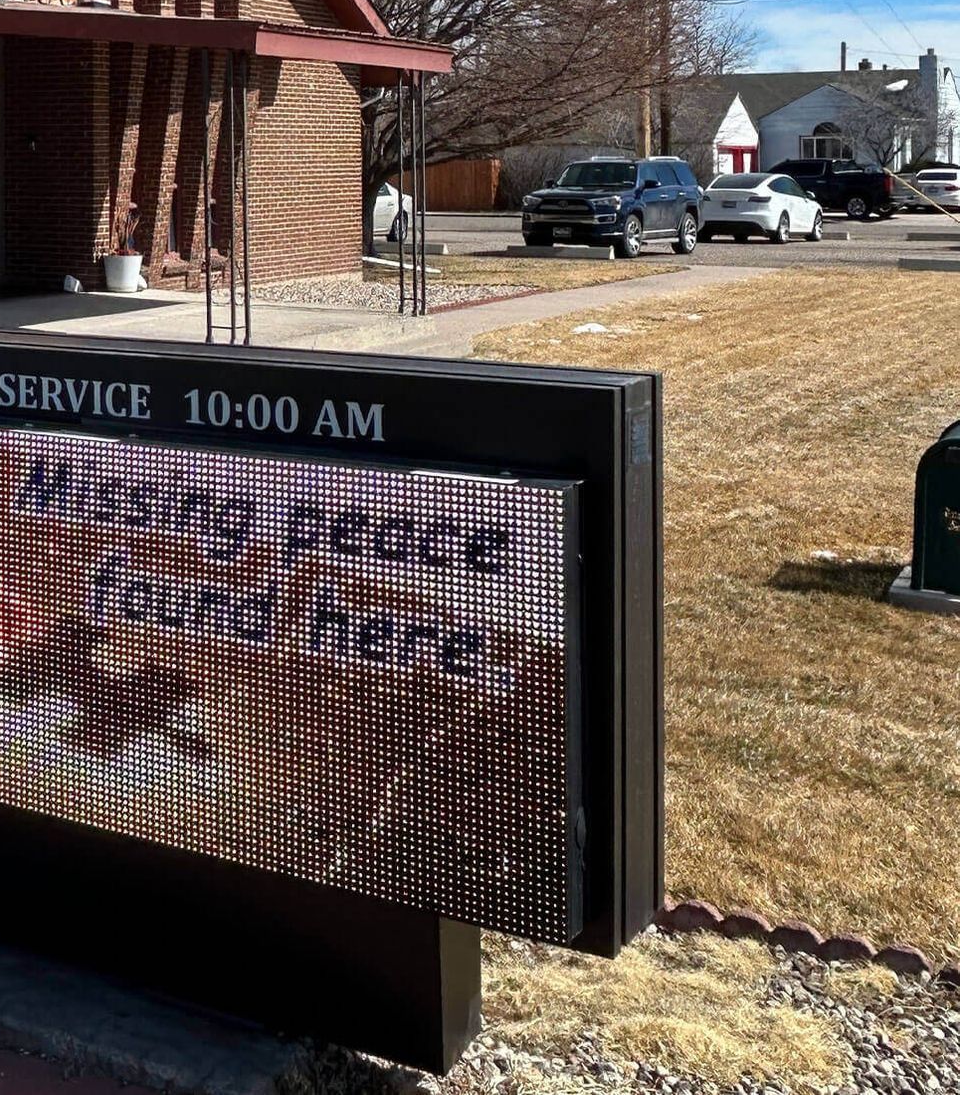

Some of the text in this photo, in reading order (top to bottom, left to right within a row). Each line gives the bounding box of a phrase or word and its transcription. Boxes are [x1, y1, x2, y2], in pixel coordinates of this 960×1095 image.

[184, 388, 300, 433] 10:00
[312, 399, 385, 442] AM
[16, 457, 512, 574] Missing peace
[88, 557, 516, 692] found here.
